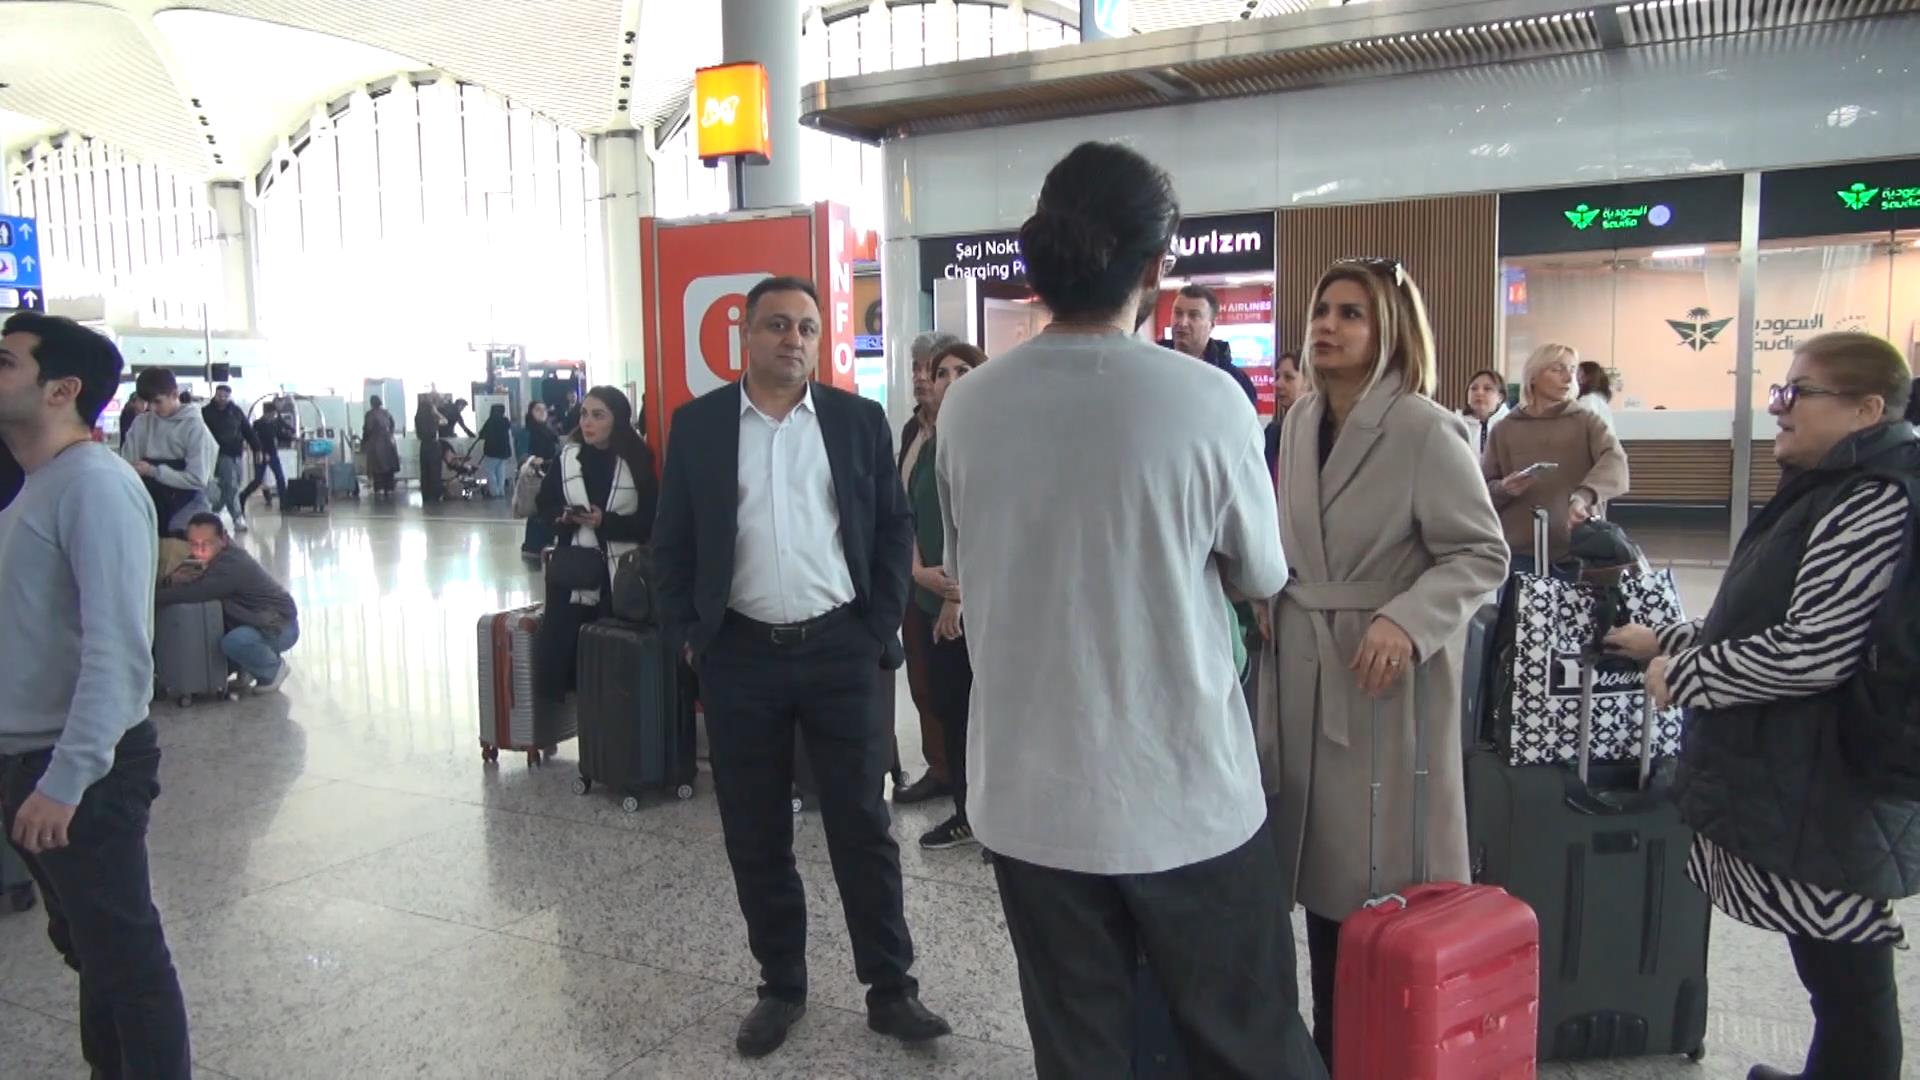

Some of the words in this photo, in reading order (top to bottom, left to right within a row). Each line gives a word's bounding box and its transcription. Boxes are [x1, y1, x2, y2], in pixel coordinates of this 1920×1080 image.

[955, 242, 982, 261] Şarj
[944, 263, 1010, 280] Charging
[831, 219, 853, 374] INFO
[1227, 301, 1272, 313] AIRLINES
[1755, 314, 1823, 336] السعودي
